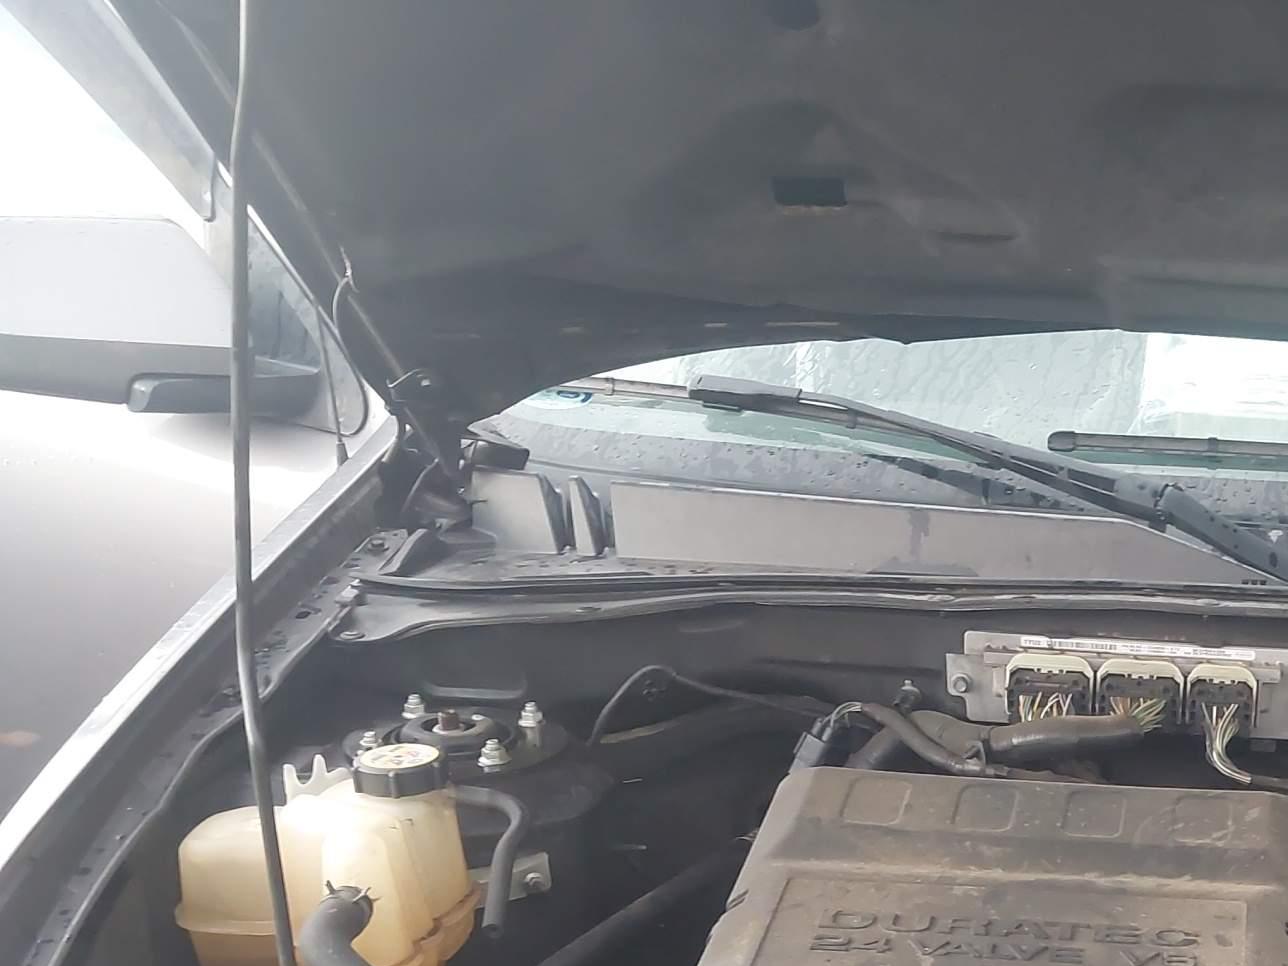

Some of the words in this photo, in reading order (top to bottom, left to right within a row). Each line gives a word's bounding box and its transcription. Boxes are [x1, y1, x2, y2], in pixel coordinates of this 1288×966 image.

[815, 908, 1200, 949] DURATEC
[810, 933, 892, 954] 24
[908, 938, 1086, 965] VALVE
